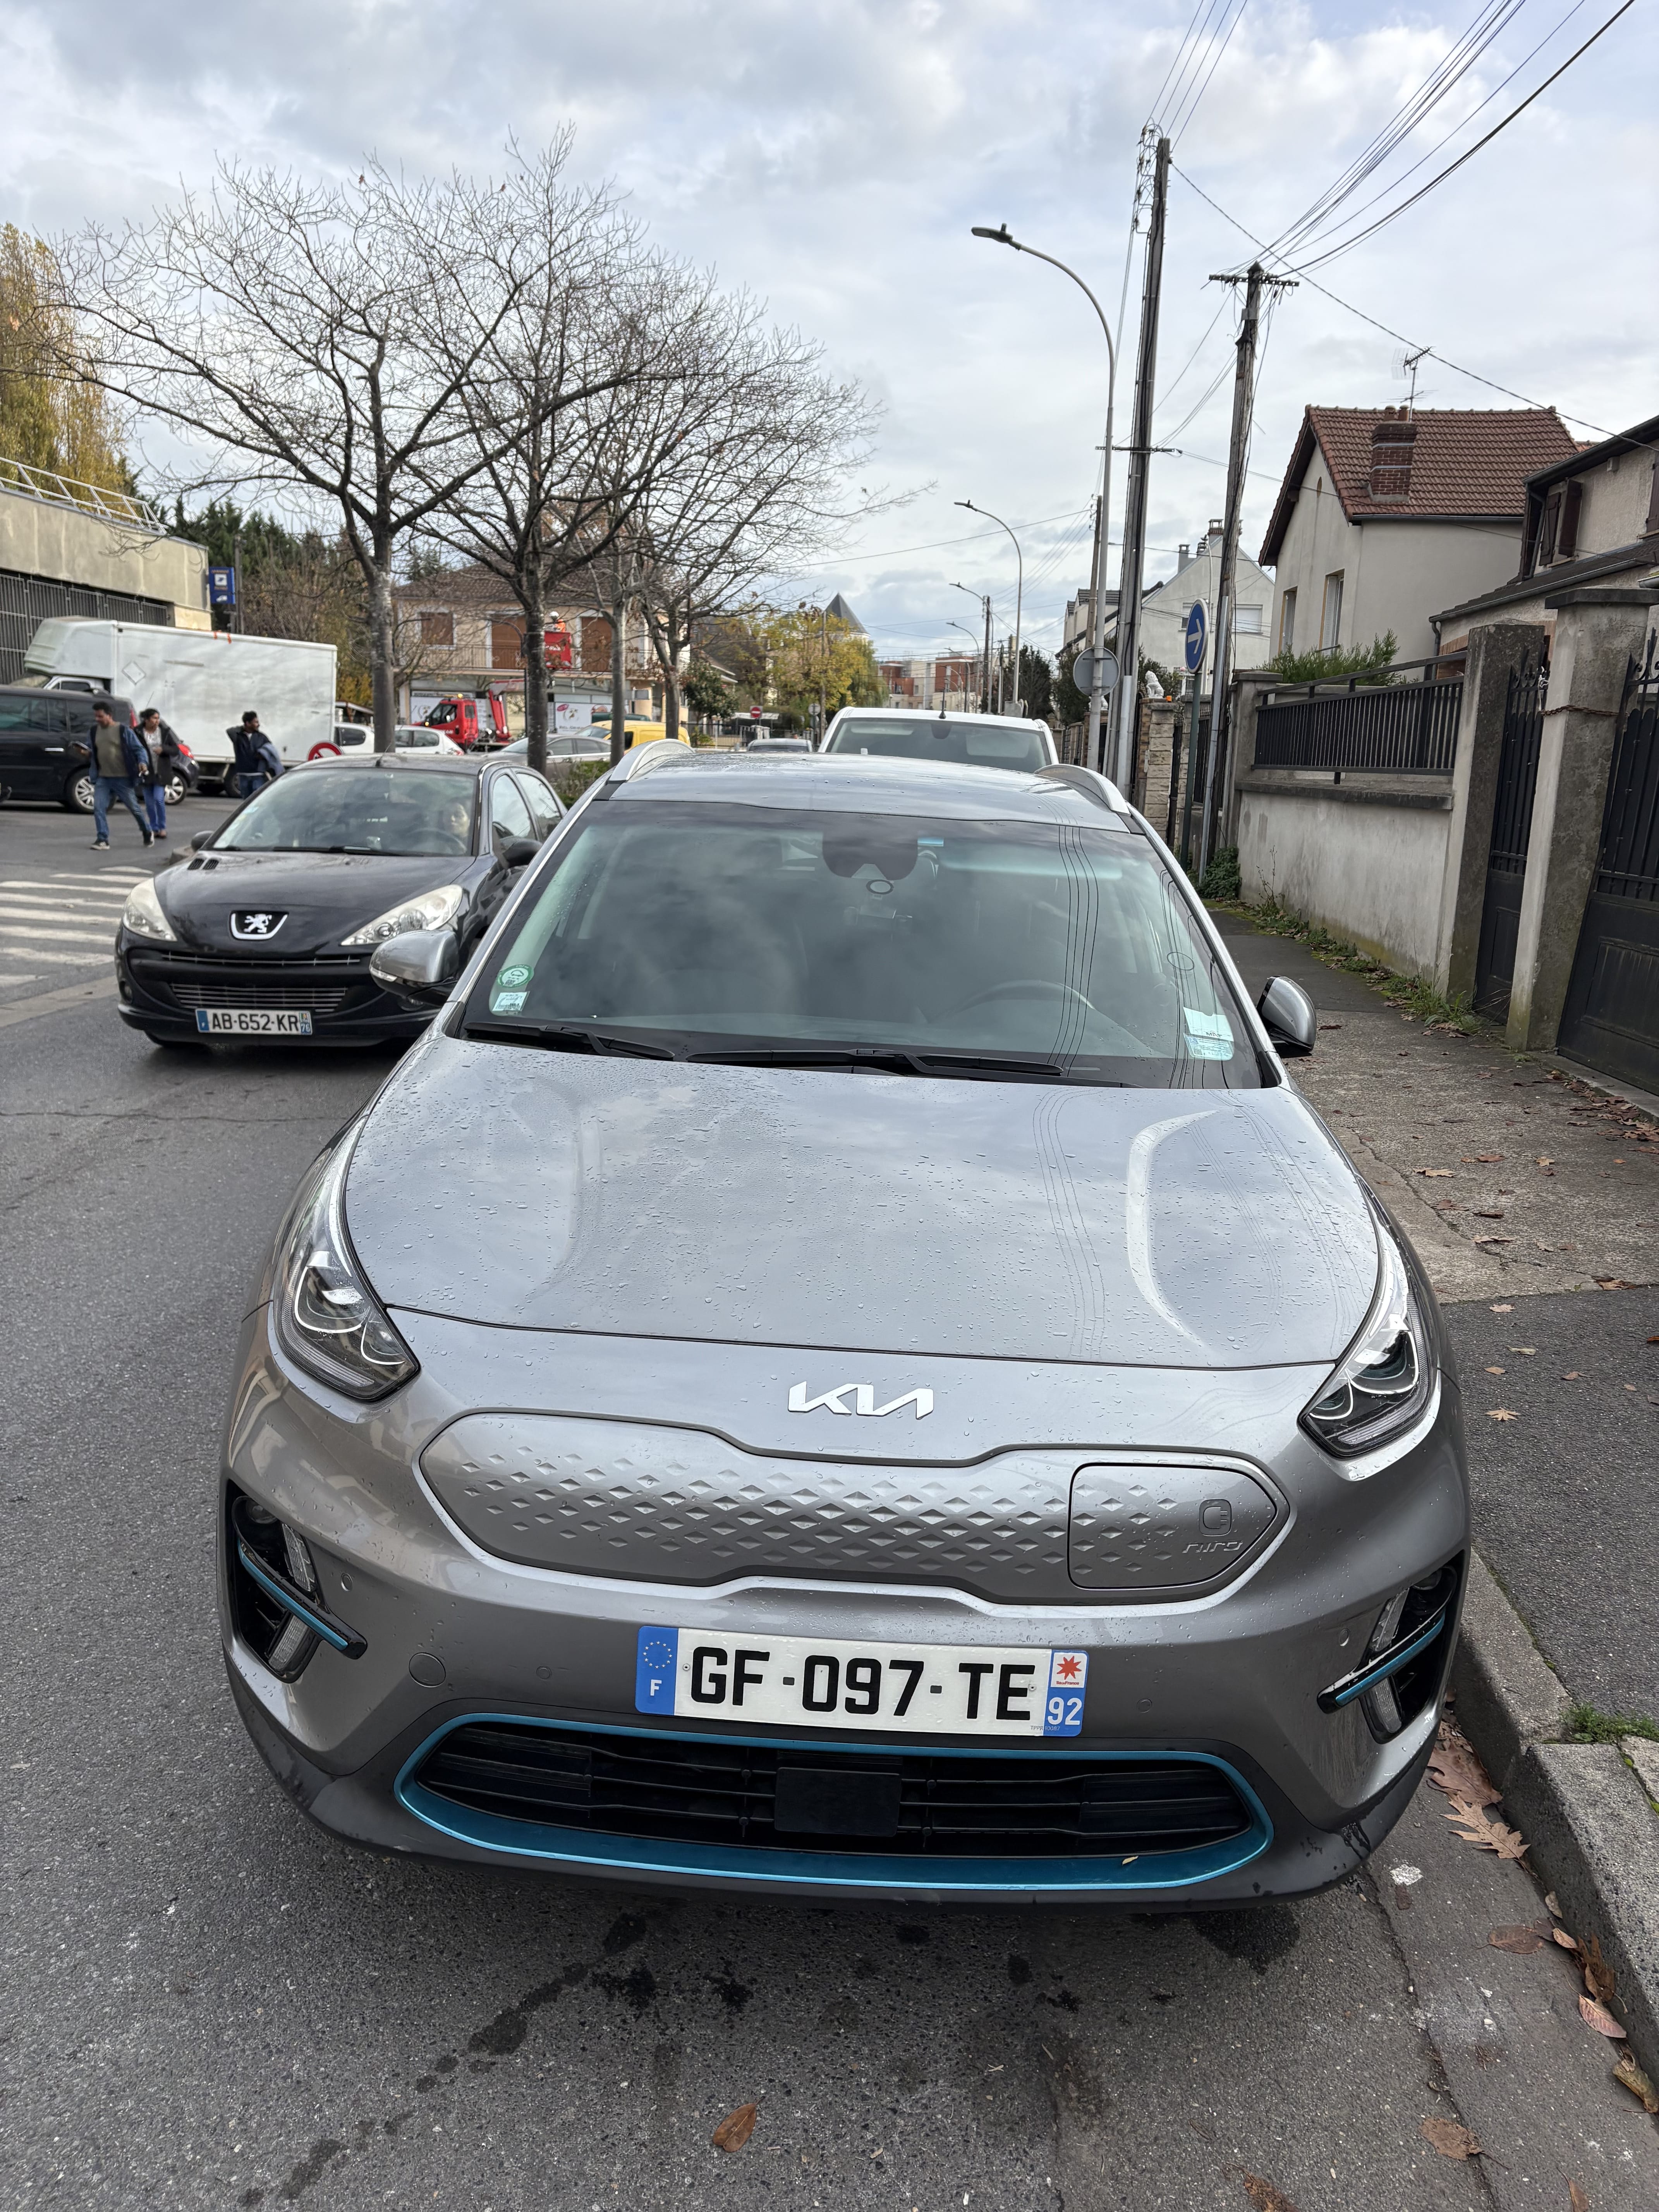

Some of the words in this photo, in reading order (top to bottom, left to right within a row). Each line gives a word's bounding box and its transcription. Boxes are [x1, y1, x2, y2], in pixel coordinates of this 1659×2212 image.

[213, 1013, 299, 1031] AB-652-KR
[650, 1679, 662, 1696] F
[691, 1646, 1035, 1720] GF-097-TE
[1048, 1697, 1082, 1725] 92
